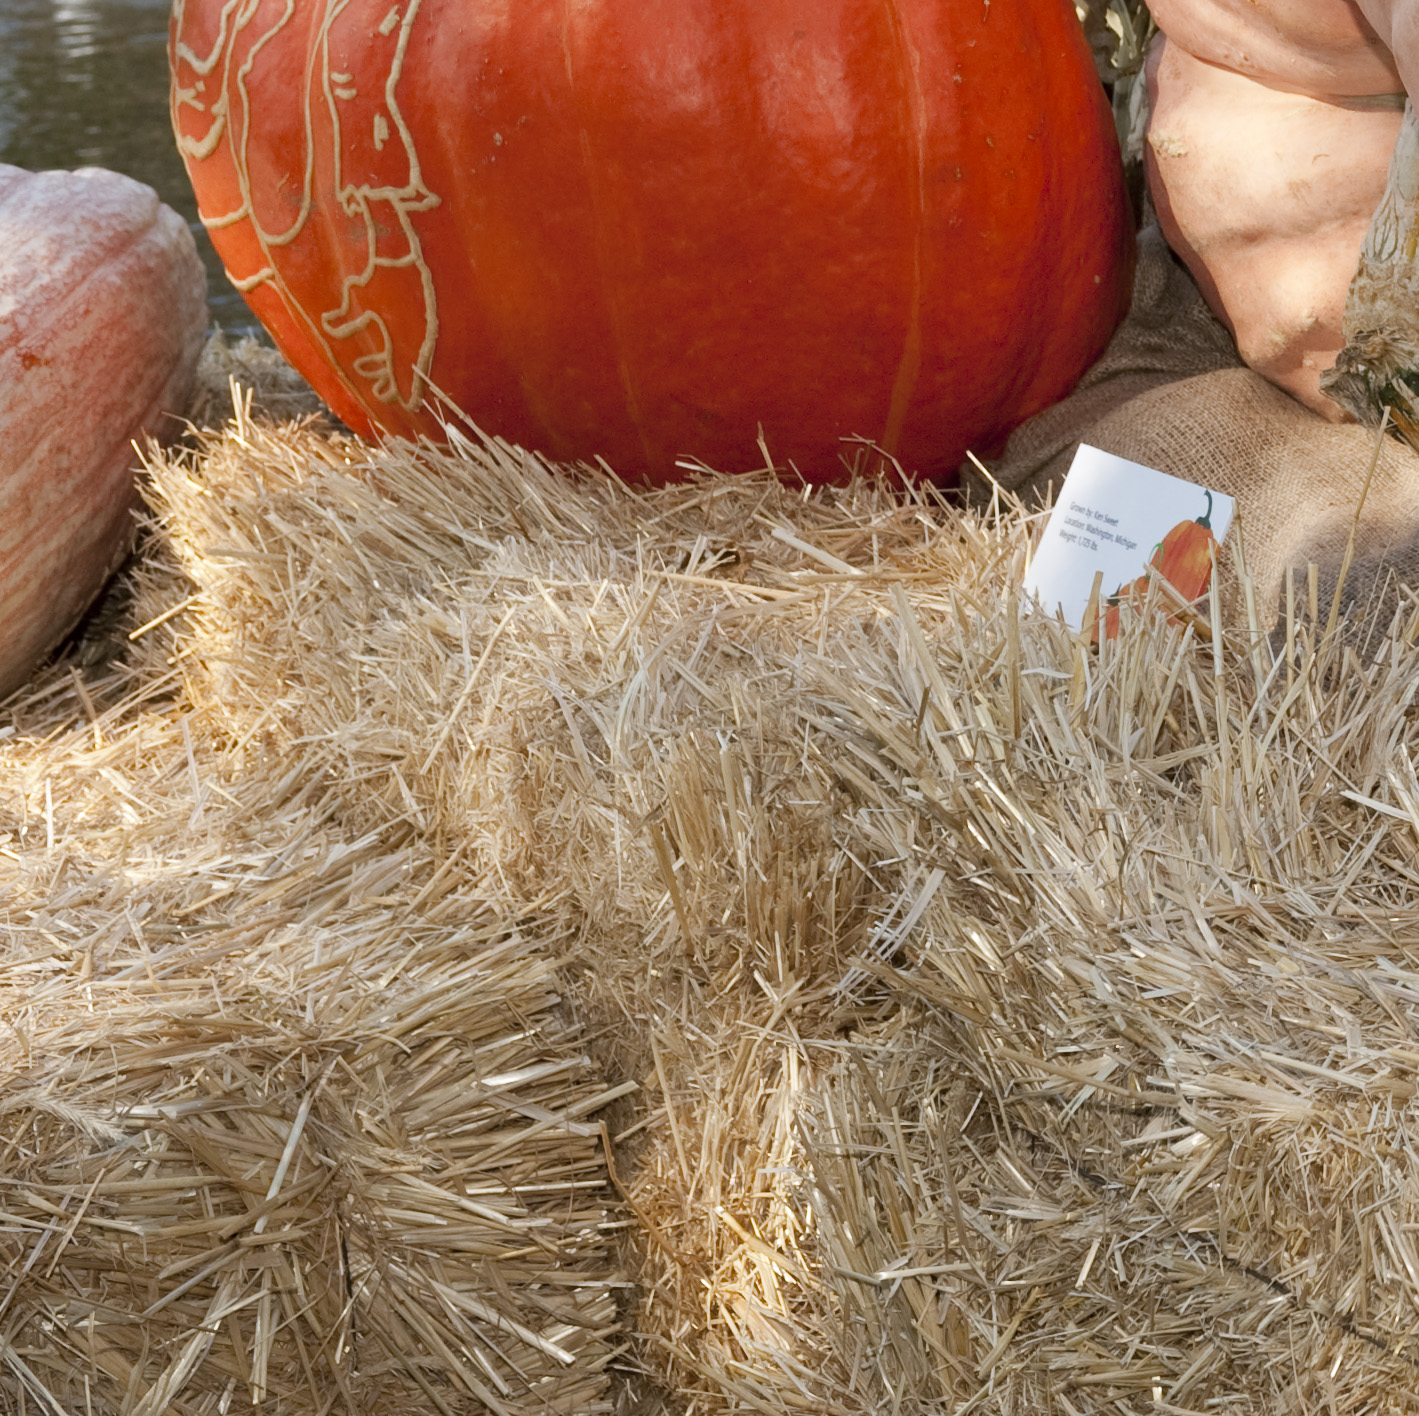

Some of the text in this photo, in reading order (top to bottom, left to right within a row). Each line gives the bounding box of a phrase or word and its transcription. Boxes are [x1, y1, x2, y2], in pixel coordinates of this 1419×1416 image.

[1070, 501, 1118, 526] Grown by: Ken Sweet
[1060, 529, 1077, 543] Weight:
[1064, 515, 1137, 550] Location: Washington, Michigan
